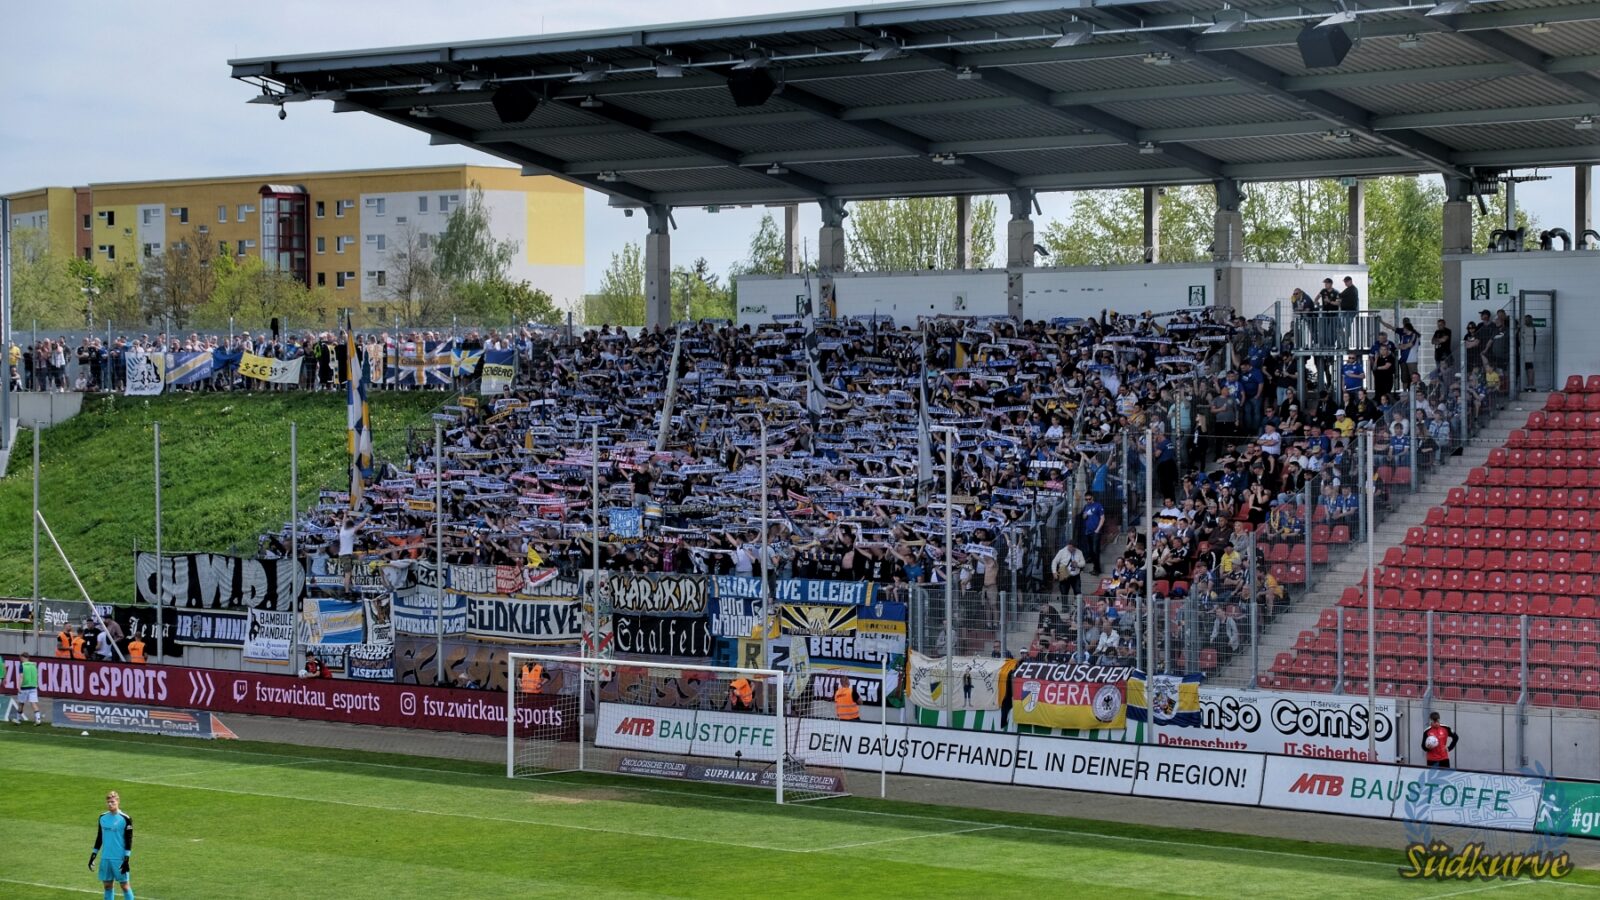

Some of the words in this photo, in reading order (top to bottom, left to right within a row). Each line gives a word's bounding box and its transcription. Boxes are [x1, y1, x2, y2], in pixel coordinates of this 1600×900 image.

[1497, 283, 1509, 294] E1
[611, 576, 707, 612] HARAKIRI
[808, 581, 864, 603] BLEIBT
[260, 612, 293, 625] BAMBULE
[468, 598, 581, 634] SÜDKURVE
[260, 626, 293, 640] RANDALE
[617, 618, 711, 656] Saalfeld
[5, 660, 85, 694] ZCKAU
[89, 666, 168, 700] eSPORTS
[1014, 662, 1132, 683] FETTGUSCHEN
[255, 682, 380, 713] fsvzwickau_esports
[1044, 684, 1092, 705] GERA
[1310, 701, 1340, 709] IT-Service
[63, 703, 148, 718] HOFMANN
[423, 699, 562, 727] fsv.zwickau.sports
[1200, 696, 1261, 732] mSo
[1271, 699, 1393, 741] ComSo
[95, 715, 160, 728] METALL
[615, 717, 655, 736] MTB
[659, 720, 775, 747] BAUSTOFFE
[1158, 733, 1247, 750] Datenschutz
[1283, 742, 1379, 761] IT-Sicherhet
[663, 762, 687, 770] FOLIEN
[808, 732, 852, 752] DEIN
[858, 736, 1038, 770] BAUSTOFFHANDEL
[1045, 753, 1065, 772] IN
[1072, 756, 1148, 780] DEINER
[1156, 762, 1247, 788] REGION!
[704, 768, 757, 781] SUPRAMAX
[810, 776, 835, 785] FOLIEN
[1288, 772, 1345, 796] MTB
[1351, 778, 1510, 812] BAUSTOFFE
